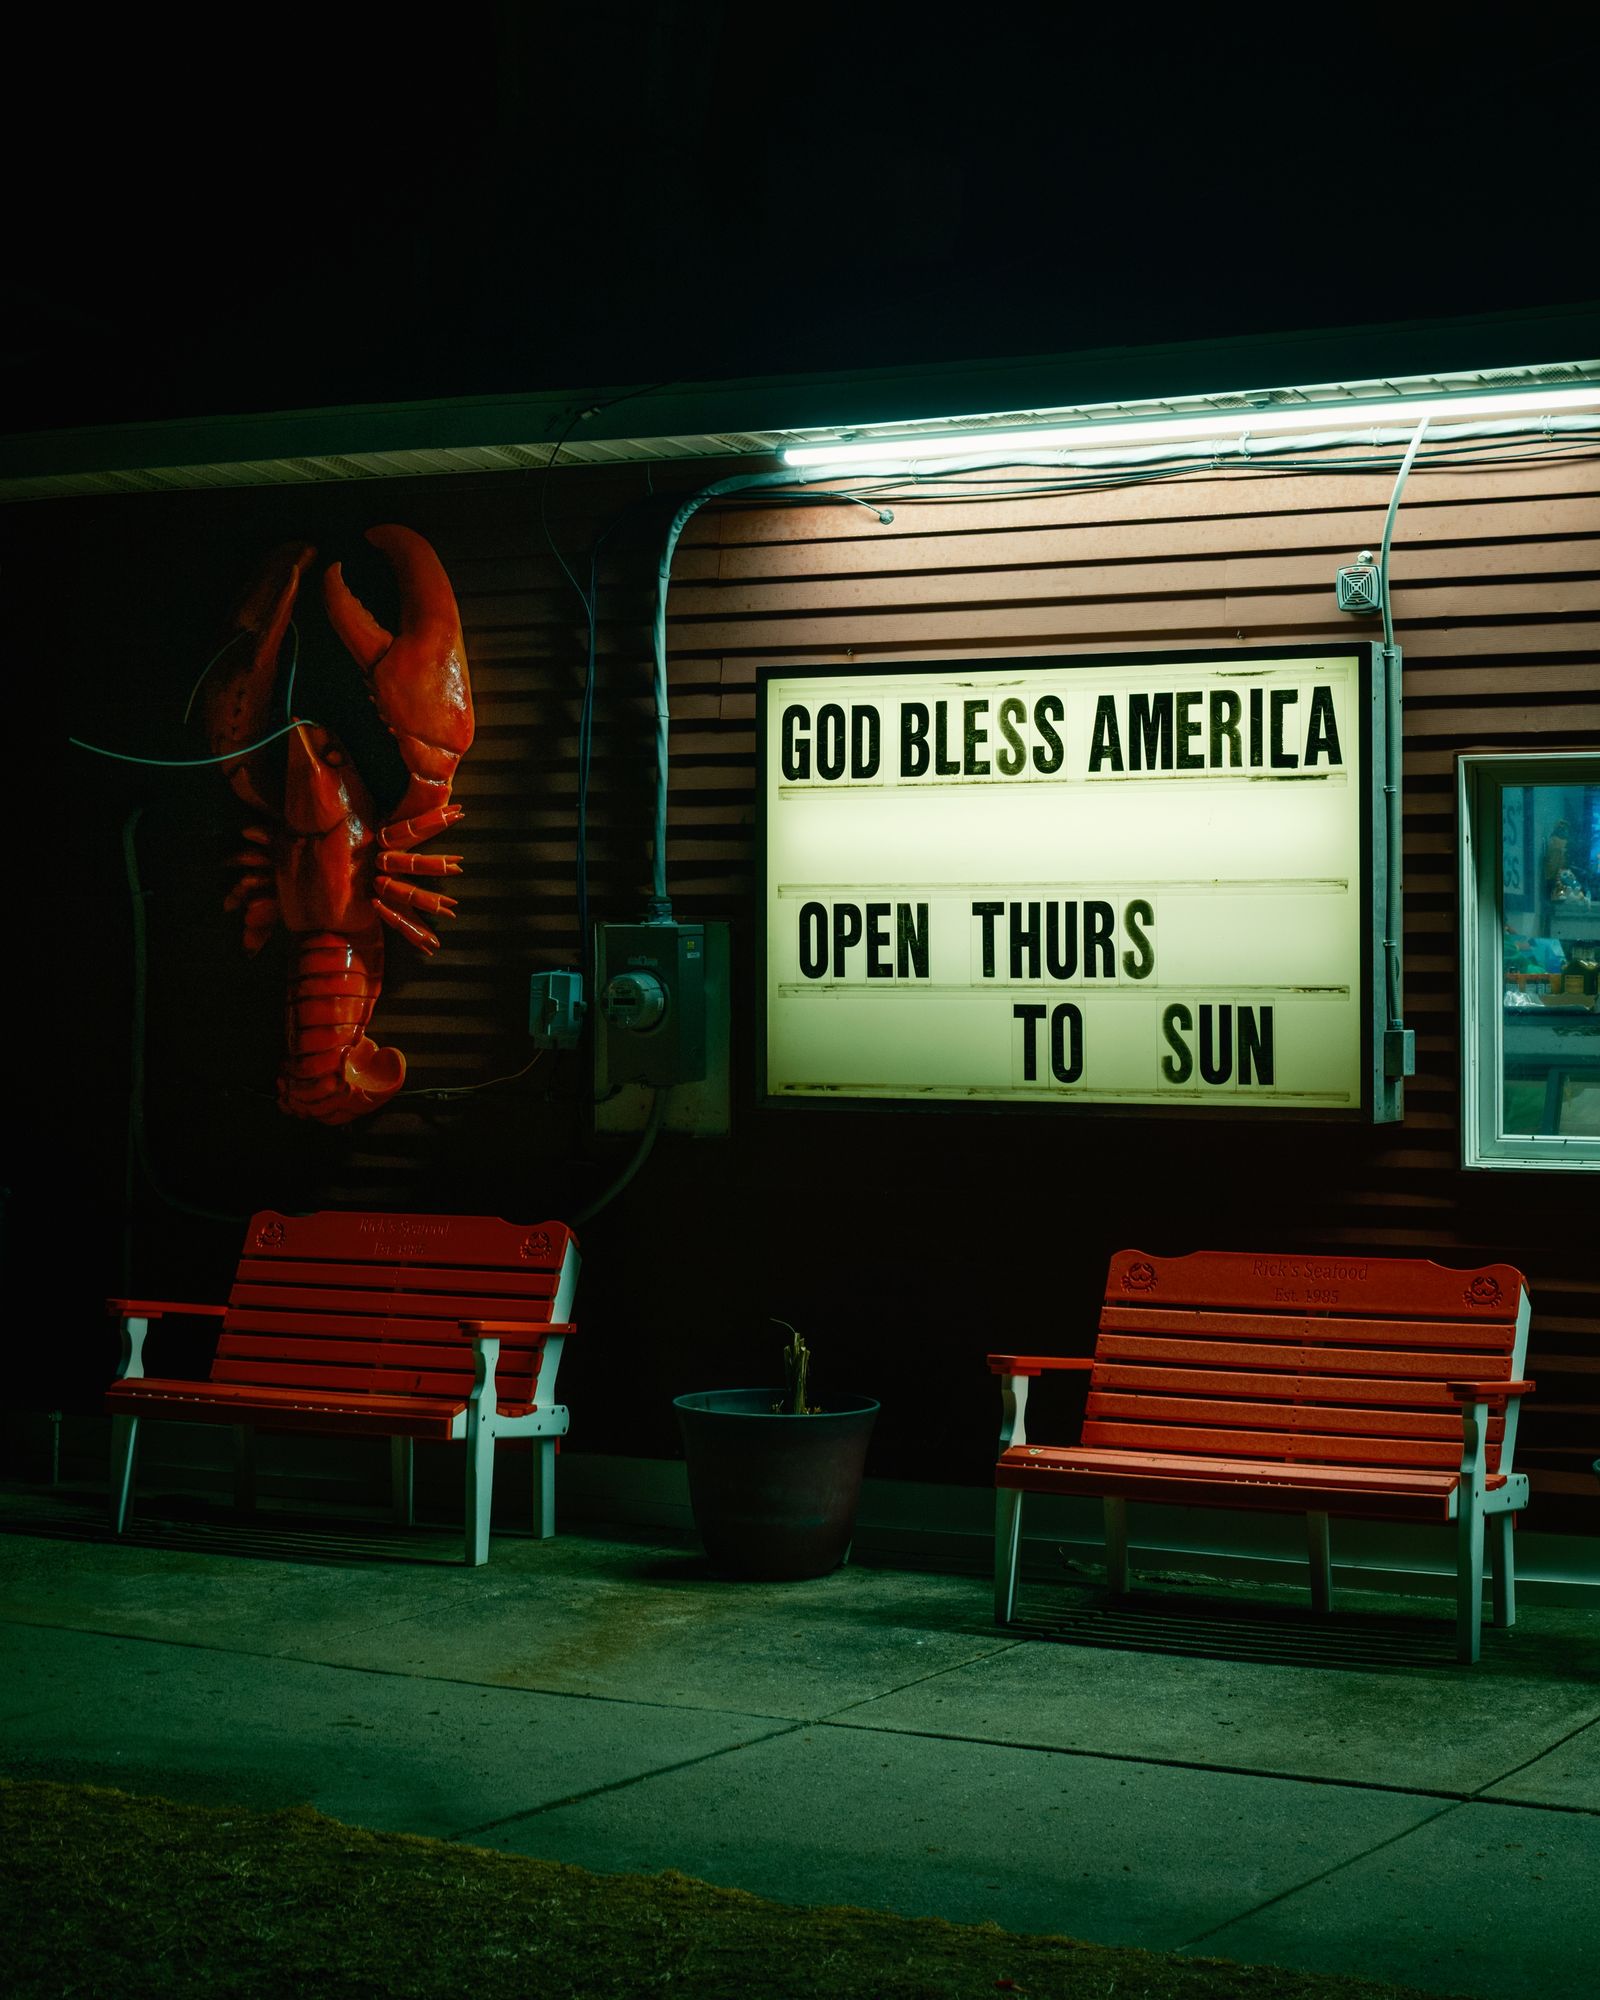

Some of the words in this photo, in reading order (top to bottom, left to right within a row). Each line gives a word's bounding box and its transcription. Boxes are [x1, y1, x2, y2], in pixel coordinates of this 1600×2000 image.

[782, 703, 881, 781] GOD
[900, 695, 1065, 777] BLESS
[1088, 686, 1343, 772] AMERICA
[799, 901, 930, 979] OPEN
[972, 898, 1155, 980] THURS
[1013, 1002, 1084, 1083] TO
[1161, 1002, 1275, 1085] SUN
[1252, 1259, 1300, 1278] Rick's
[1303, 1262, 1369, 1281] Seafood
[1274, 1287, 1299, 1302] Est.
[1306, 1289, 1340, 1304] 1985
